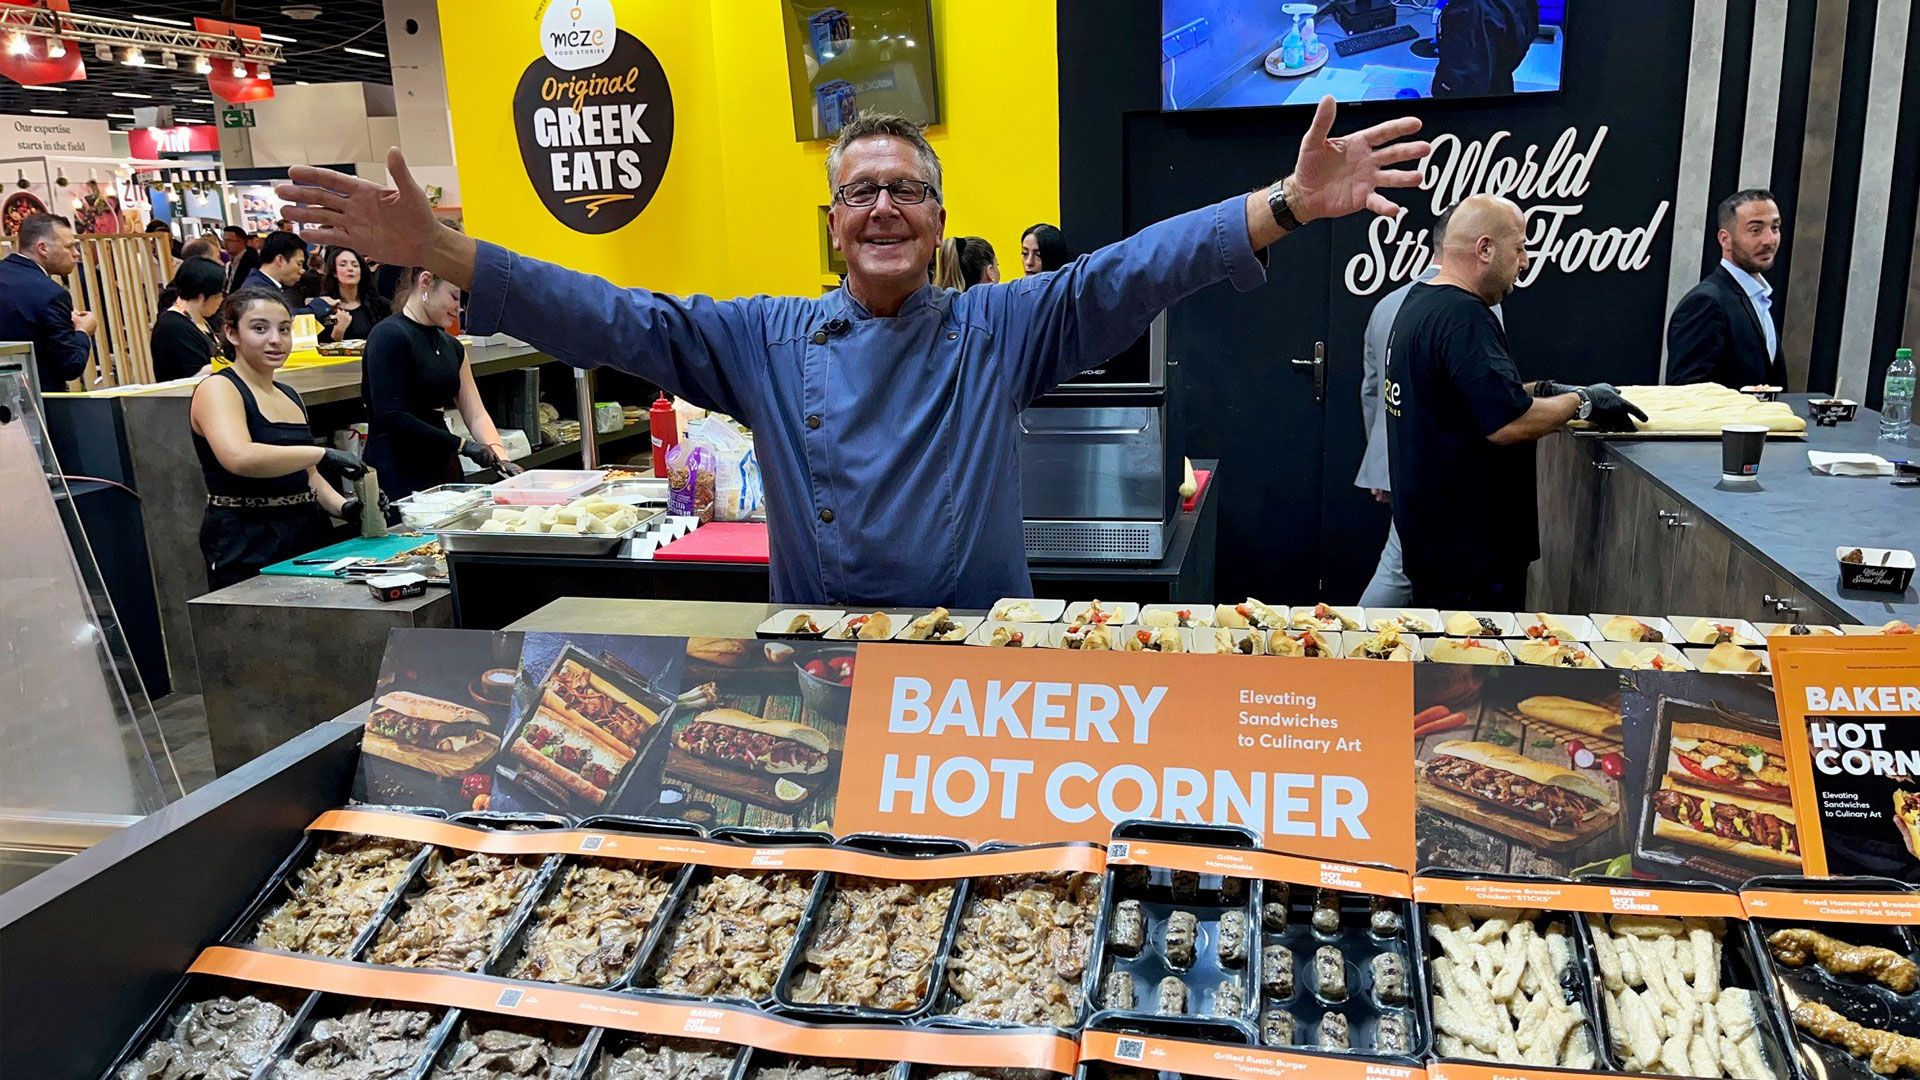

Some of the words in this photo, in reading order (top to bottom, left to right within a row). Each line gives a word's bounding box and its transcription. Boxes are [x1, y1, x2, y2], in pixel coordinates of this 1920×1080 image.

[550, 29, 604, 48] meze
[541, 67, 639, 114] Original
[14, 121, 32, 132] Our
[34, 123, 71, 135] expertise
[533, 103, 651, 147] GREEK
[18, 141, 42, 151] starts
[43, 141, 52, 150] in
[54, 142, 67, 151] the
[68, 142, 85, 151] field
[550, 149, 642, 192] EATS
[1417, 125, 1608, 216] World
[1344, 206, 1434, 295] Str
[1515, 200, 1669, 288] Food
[1239, 689, 1316, 709] Elevating
[888, 676, 1168, 744] BAKERY
[1238, 711, 1338, 730] Sandwiches
[1810, 722, 1886, 749] HOT
[1237, 733, 1254, 748] to
[1259, 734, 1331, 754] Culinary
[1335, 736, 1362, 753] Art
[878, 753, 1034, 820] HOT
[1045, 760, 1371, 840] CORNER
[1822, 792, 1858, 801] Elevating
[1823, 801, 1870, 809] Sandwiches
[1835, 810, 1868, 819] Culinary
[1869, 810, 1882, 818] Art
[1216, 854, 1243, 862] Grilled
[1320, 863, 1359, 874] BAKERY
[1320, 871, 1342, 880] HOT
[1320, 878, 1362, 888] CORNER
[1465, 885, 1487, 893] Fried
[1609, 888, 1651, 898] BAKERY
[1611, 897, 1635, 905] HOT
[1802, 898, 1827, 906] Fried
[1829, 899, 1879, 909] Homestyle
[1613, 903, 1660, 912] CORNER
[1818, 907, 1858, 916] Chicken
[1859, 908, 1885, 917] Fillet
[1885, 908, 1912, 918] Strips
[689, 1009, 726, 1018] BAKERY
[686, 1018, 706, 1026] HOT
[682, 1024, 721, 1035] CORNER
[1213, 1052, 1245, 1063] Grilled
[1246, 1055, 1274, 1066] Rustic
[1276, 1059, 1308, 1071] Burger
[1365, 1065, 1411, 1079] BAKERY
